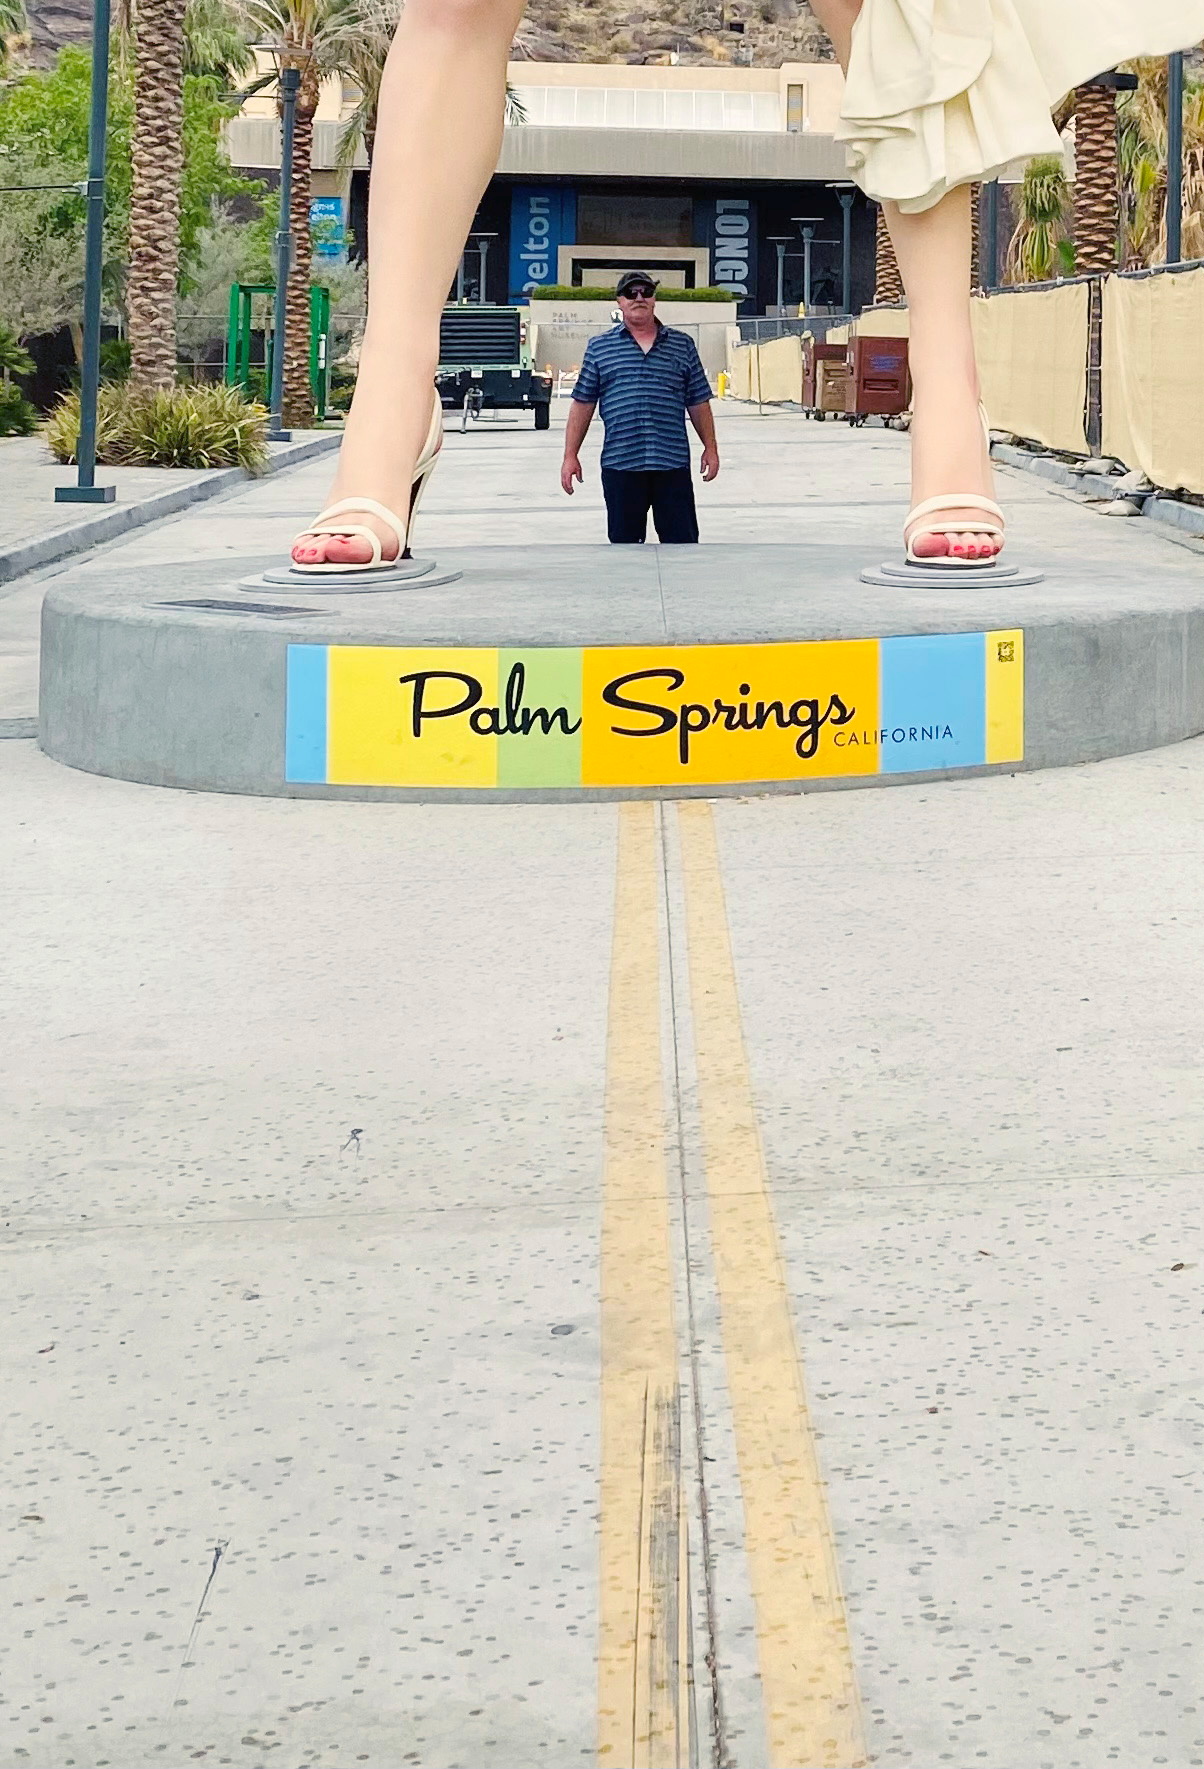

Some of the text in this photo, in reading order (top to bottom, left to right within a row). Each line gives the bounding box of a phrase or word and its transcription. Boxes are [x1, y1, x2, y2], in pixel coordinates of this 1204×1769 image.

[399, 662, 856, 764] Palm Springs
[833, 725, 953, 747] CALIFORNIA
